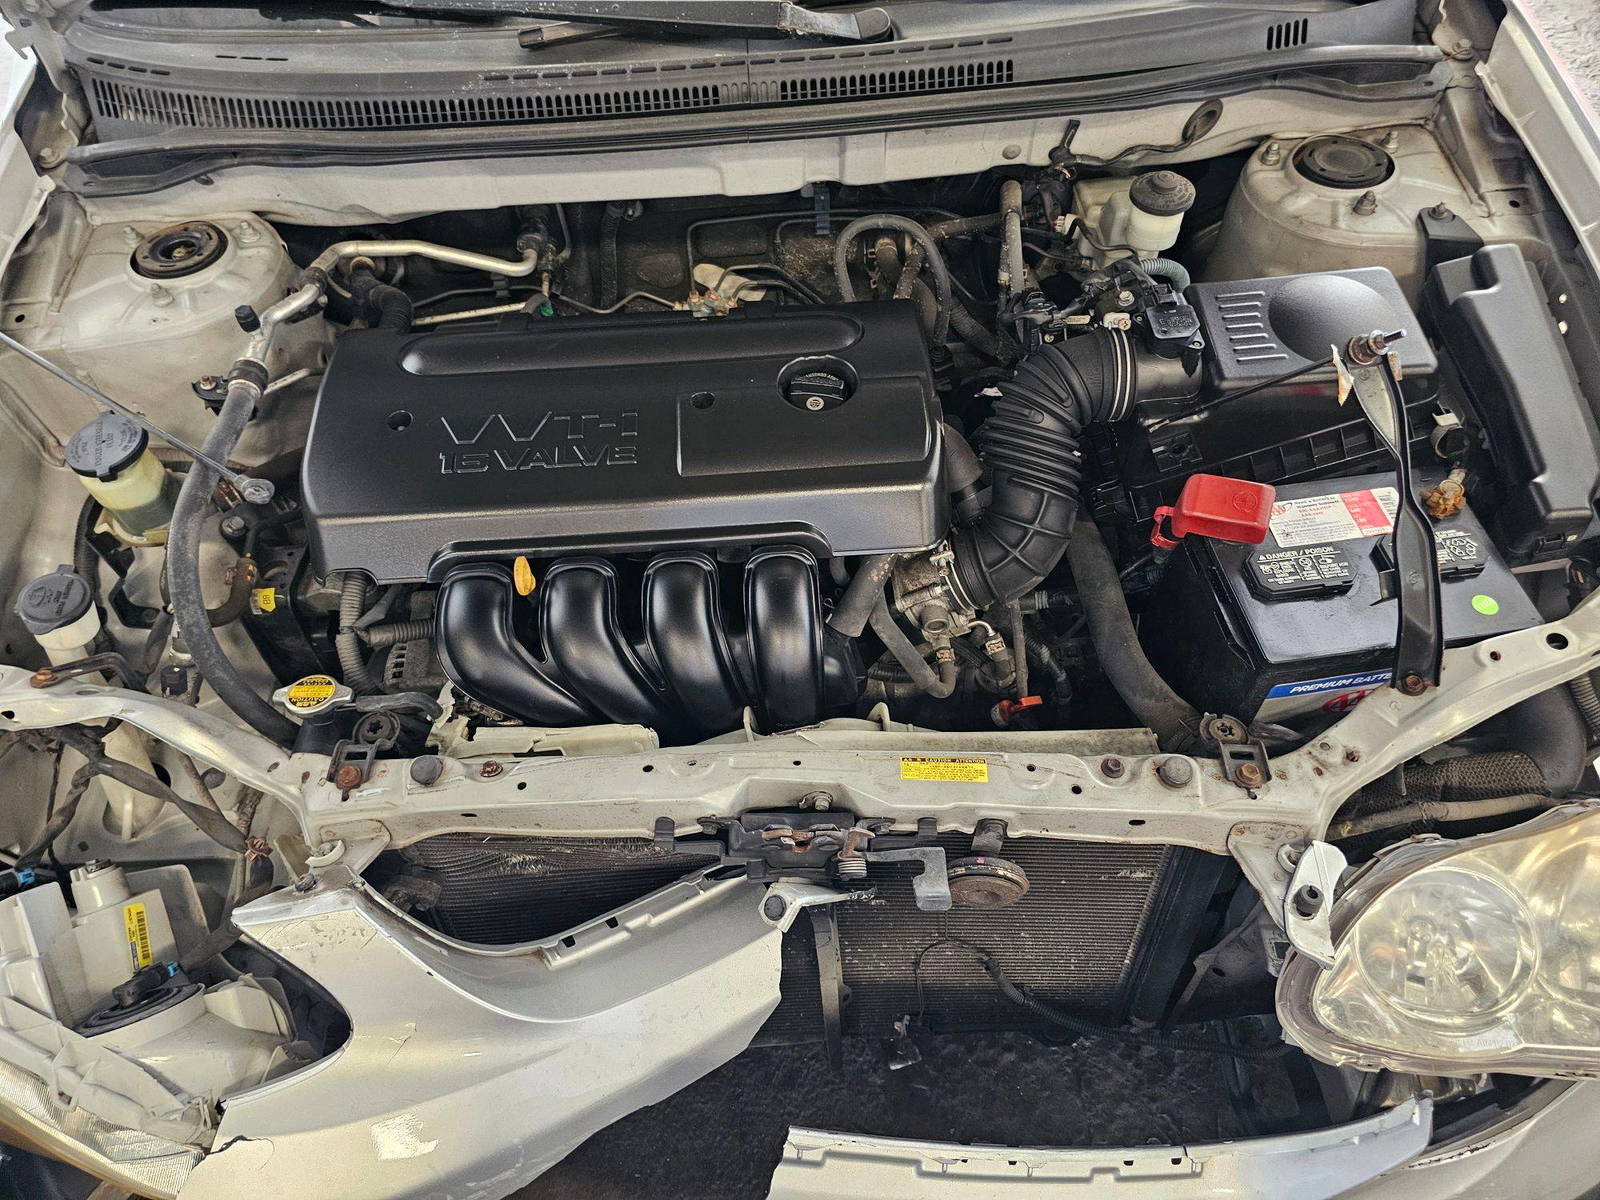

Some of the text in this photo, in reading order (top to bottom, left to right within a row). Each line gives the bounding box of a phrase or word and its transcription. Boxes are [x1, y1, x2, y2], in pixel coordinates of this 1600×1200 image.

[1265, 550, 1298, 560] DANGER
[1304, 546, 1334, 555] POISON
[1289, 672, 1392, 694] PREMIUM BATTE
